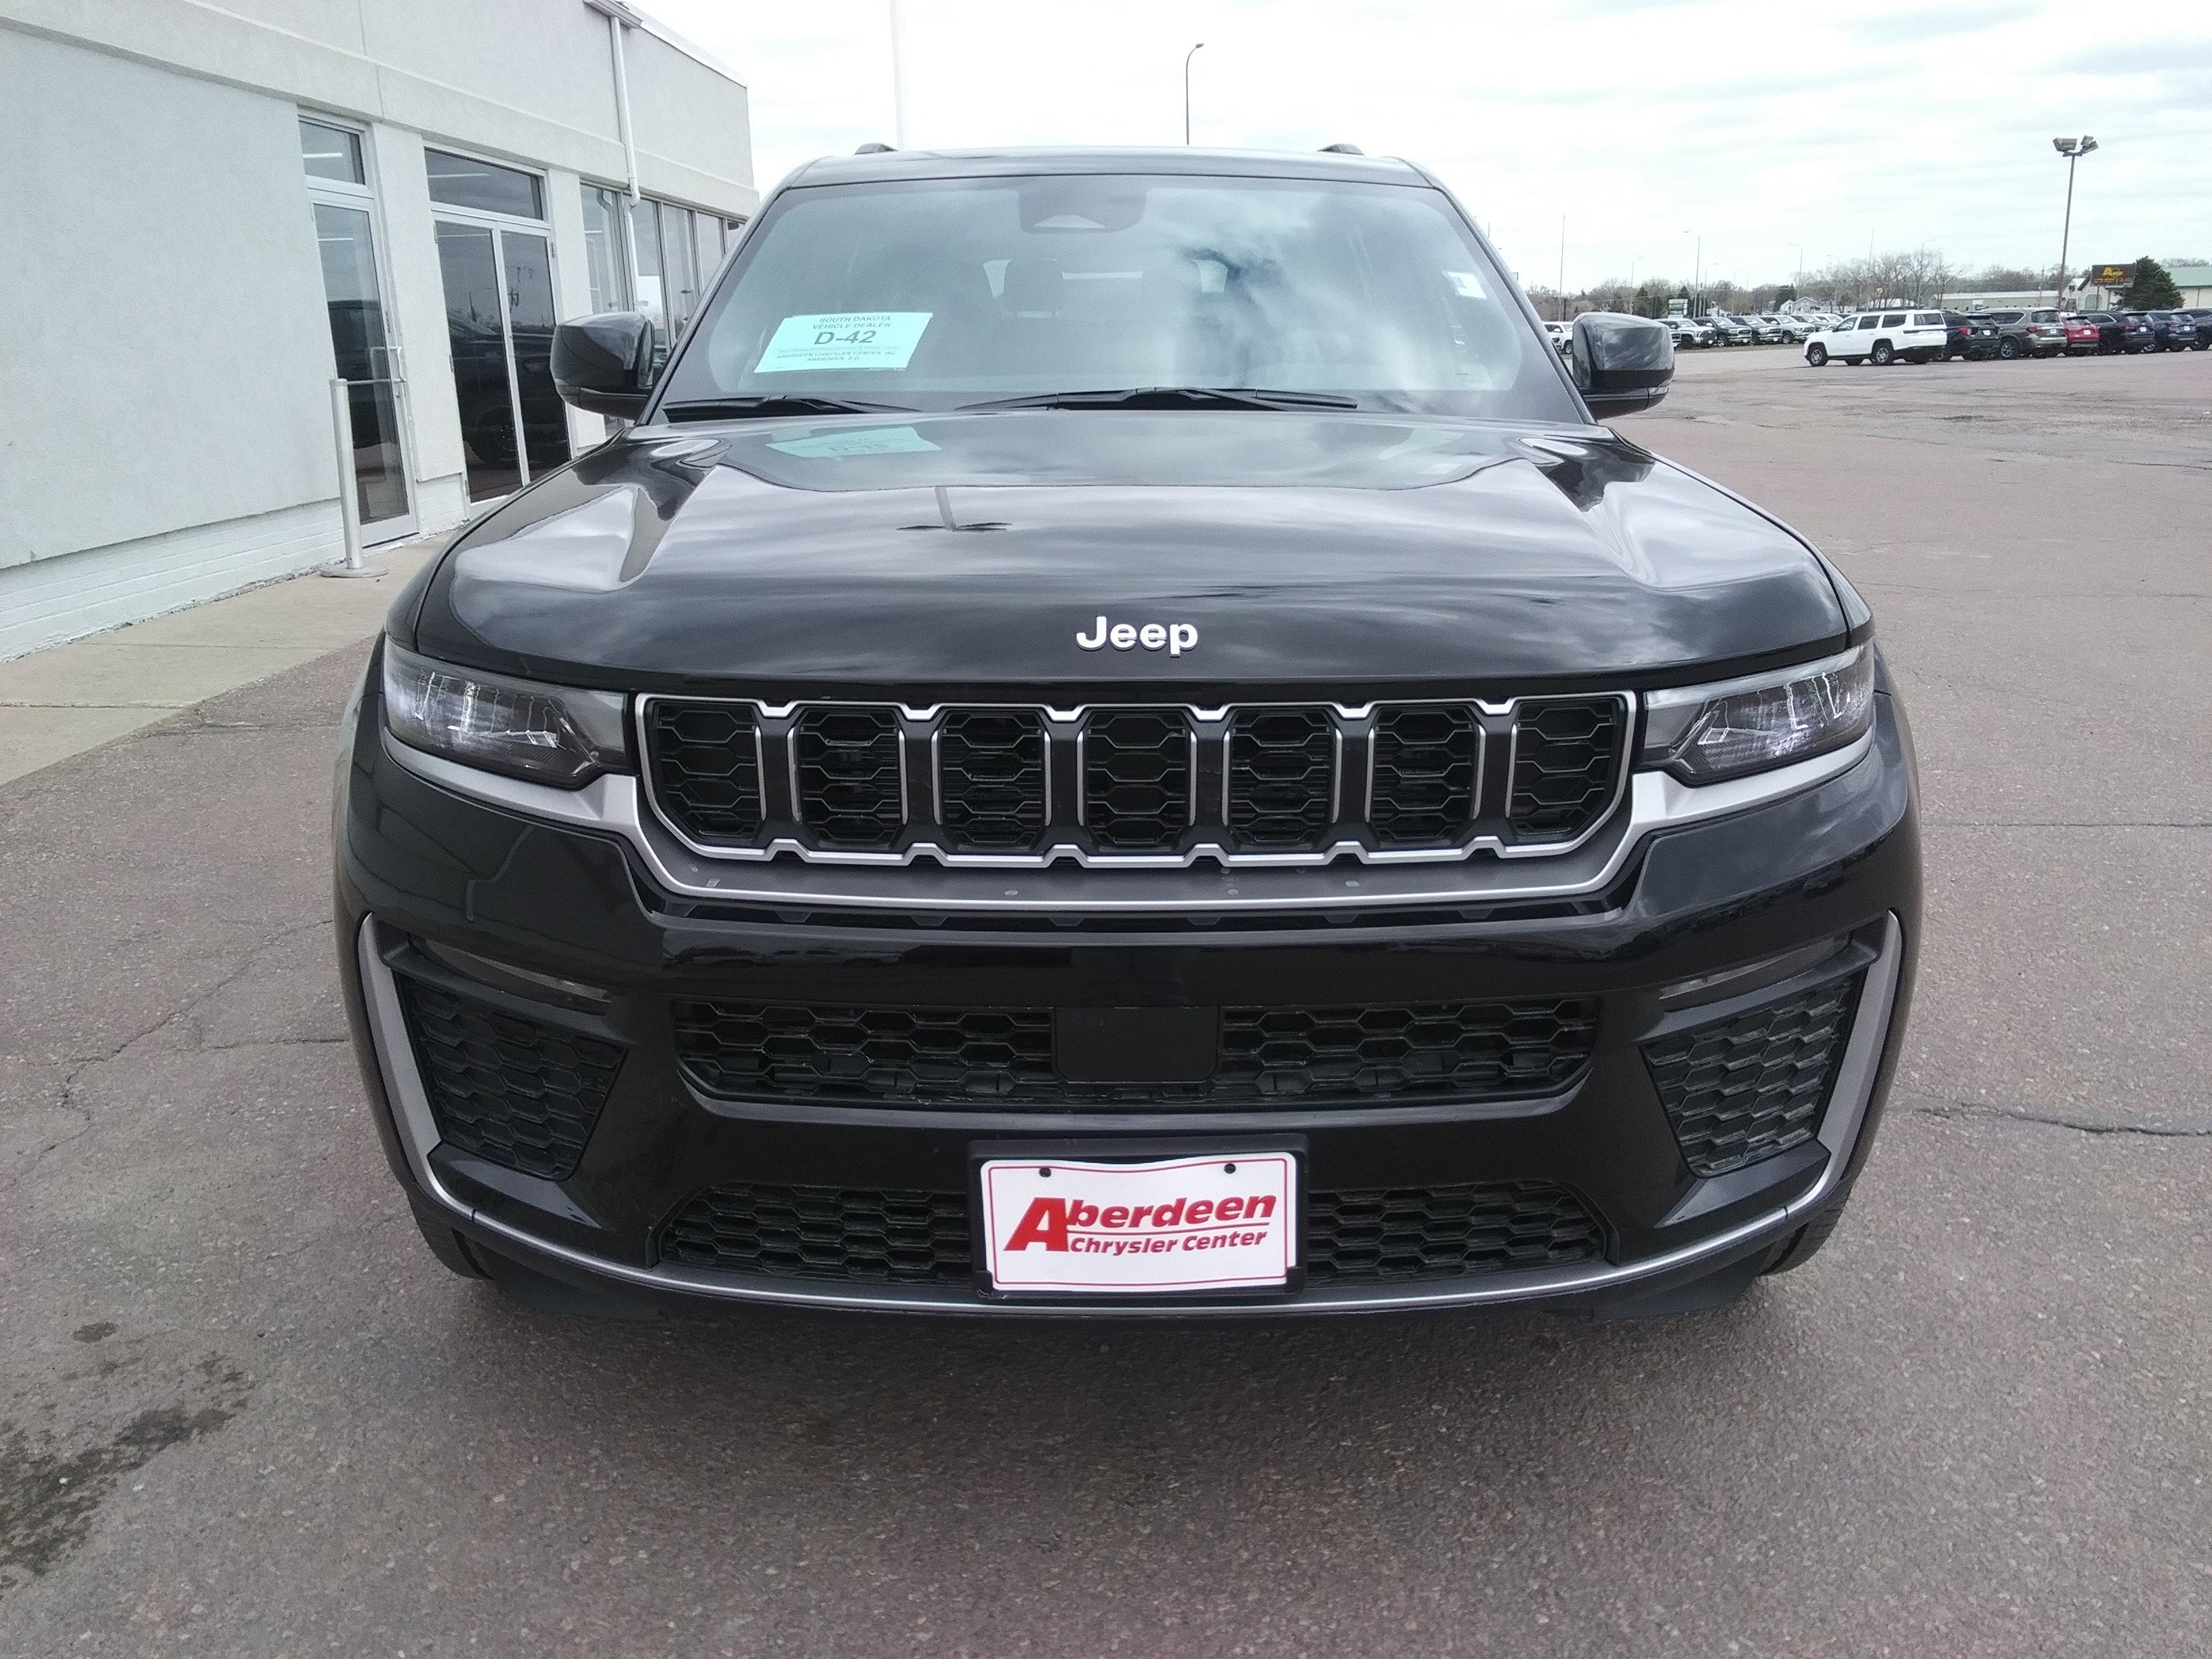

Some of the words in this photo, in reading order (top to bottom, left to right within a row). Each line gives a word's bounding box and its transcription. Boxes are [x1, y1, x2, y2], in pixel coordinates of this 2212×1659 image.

[814, 330, 877, 345] D-42
[1076, 615, 1198, 658] Jeep
[1003, 1195, 1276, 1252] Aberdeen
[1071, 1237, 1179, 1256] Chrysler
[1182, 1231, 1267, 1251] Center
